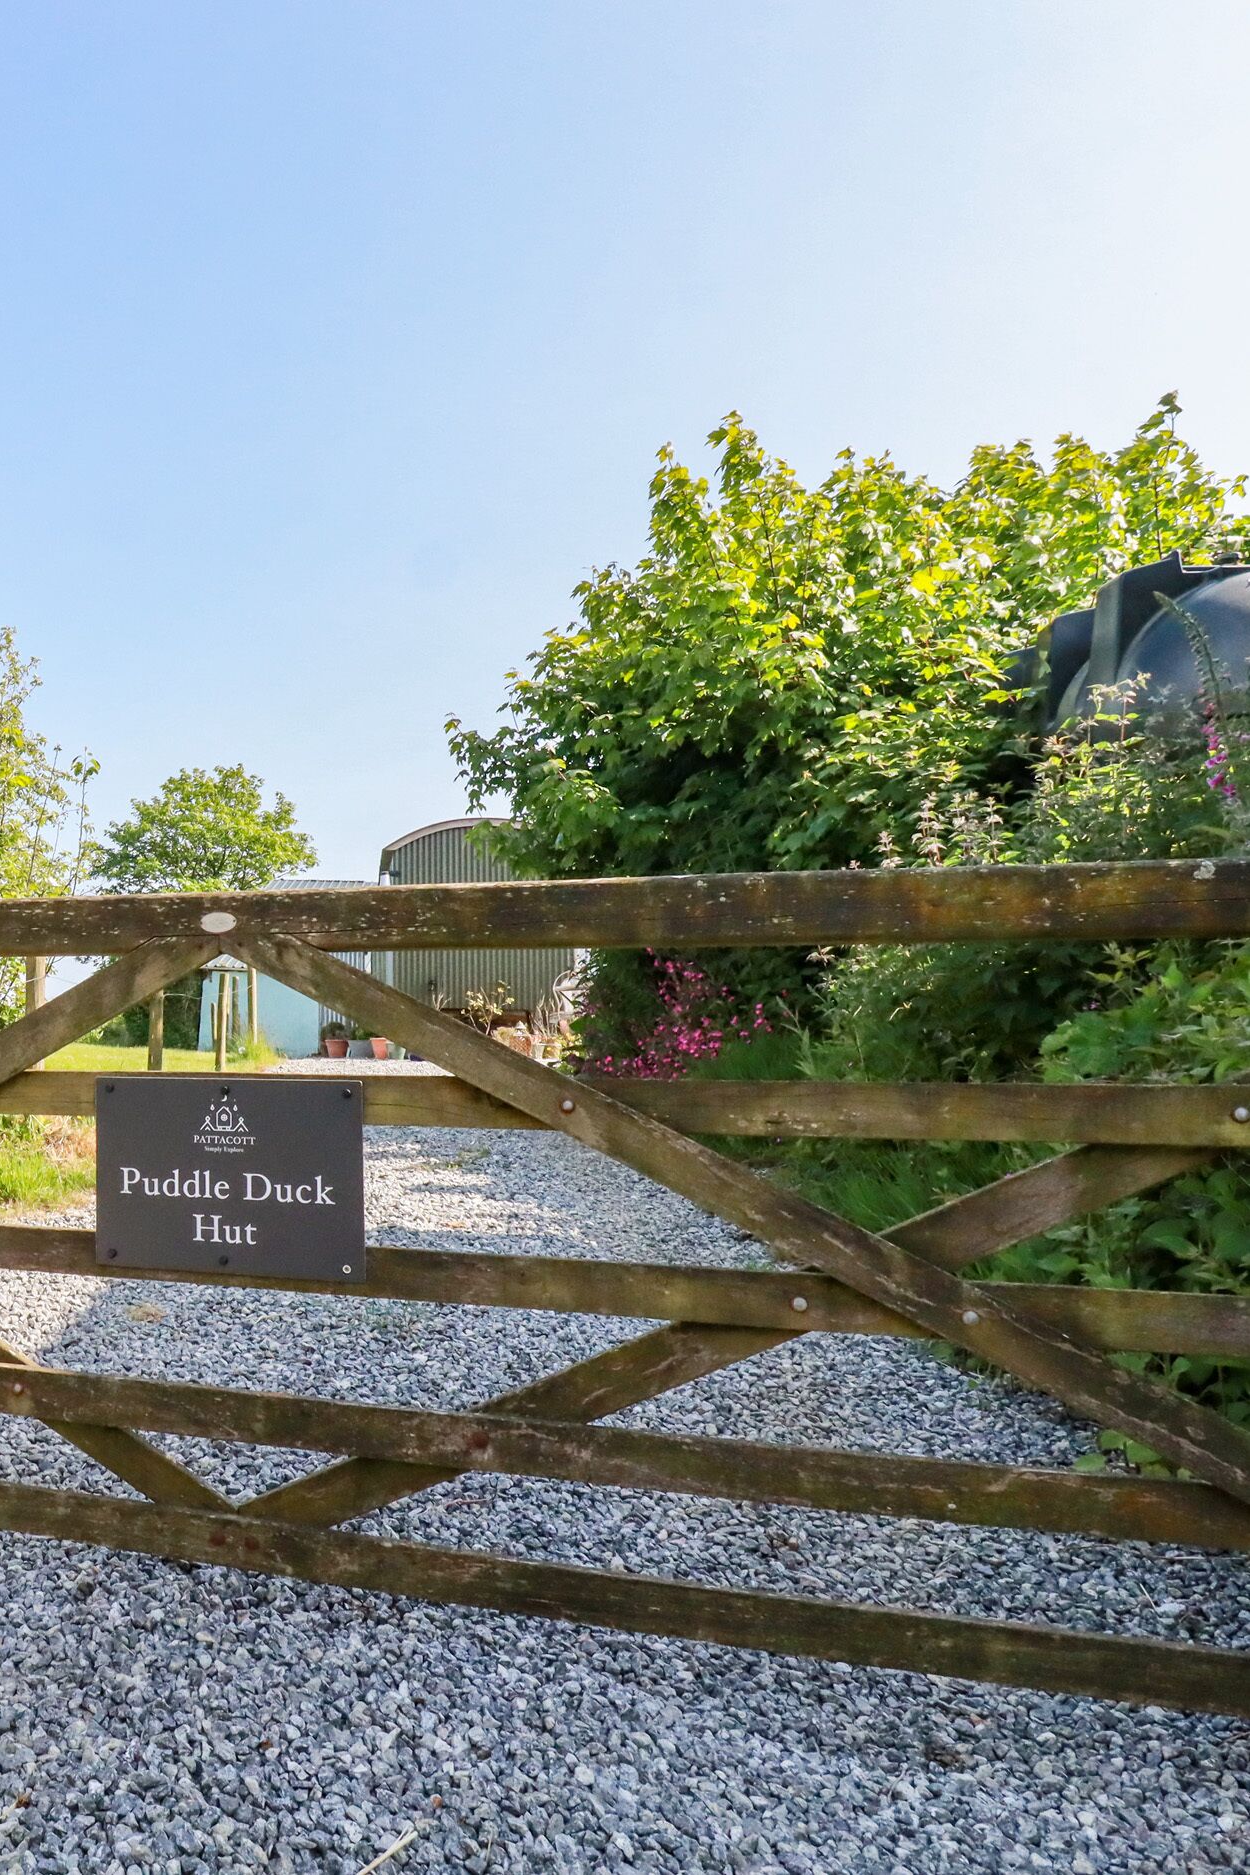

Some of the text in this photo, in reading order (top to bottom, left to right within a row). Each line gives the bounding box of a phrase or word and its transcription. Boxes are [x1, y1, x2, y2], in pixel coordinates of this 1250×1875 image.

[193, 1134, 256, 1145] PATTACOTT
[204, 1146, 244, 1154] Simply Explore
[119, 1166, 336, 1205] Puddle Duck
[192, 1213, 257, 1245] Hut
